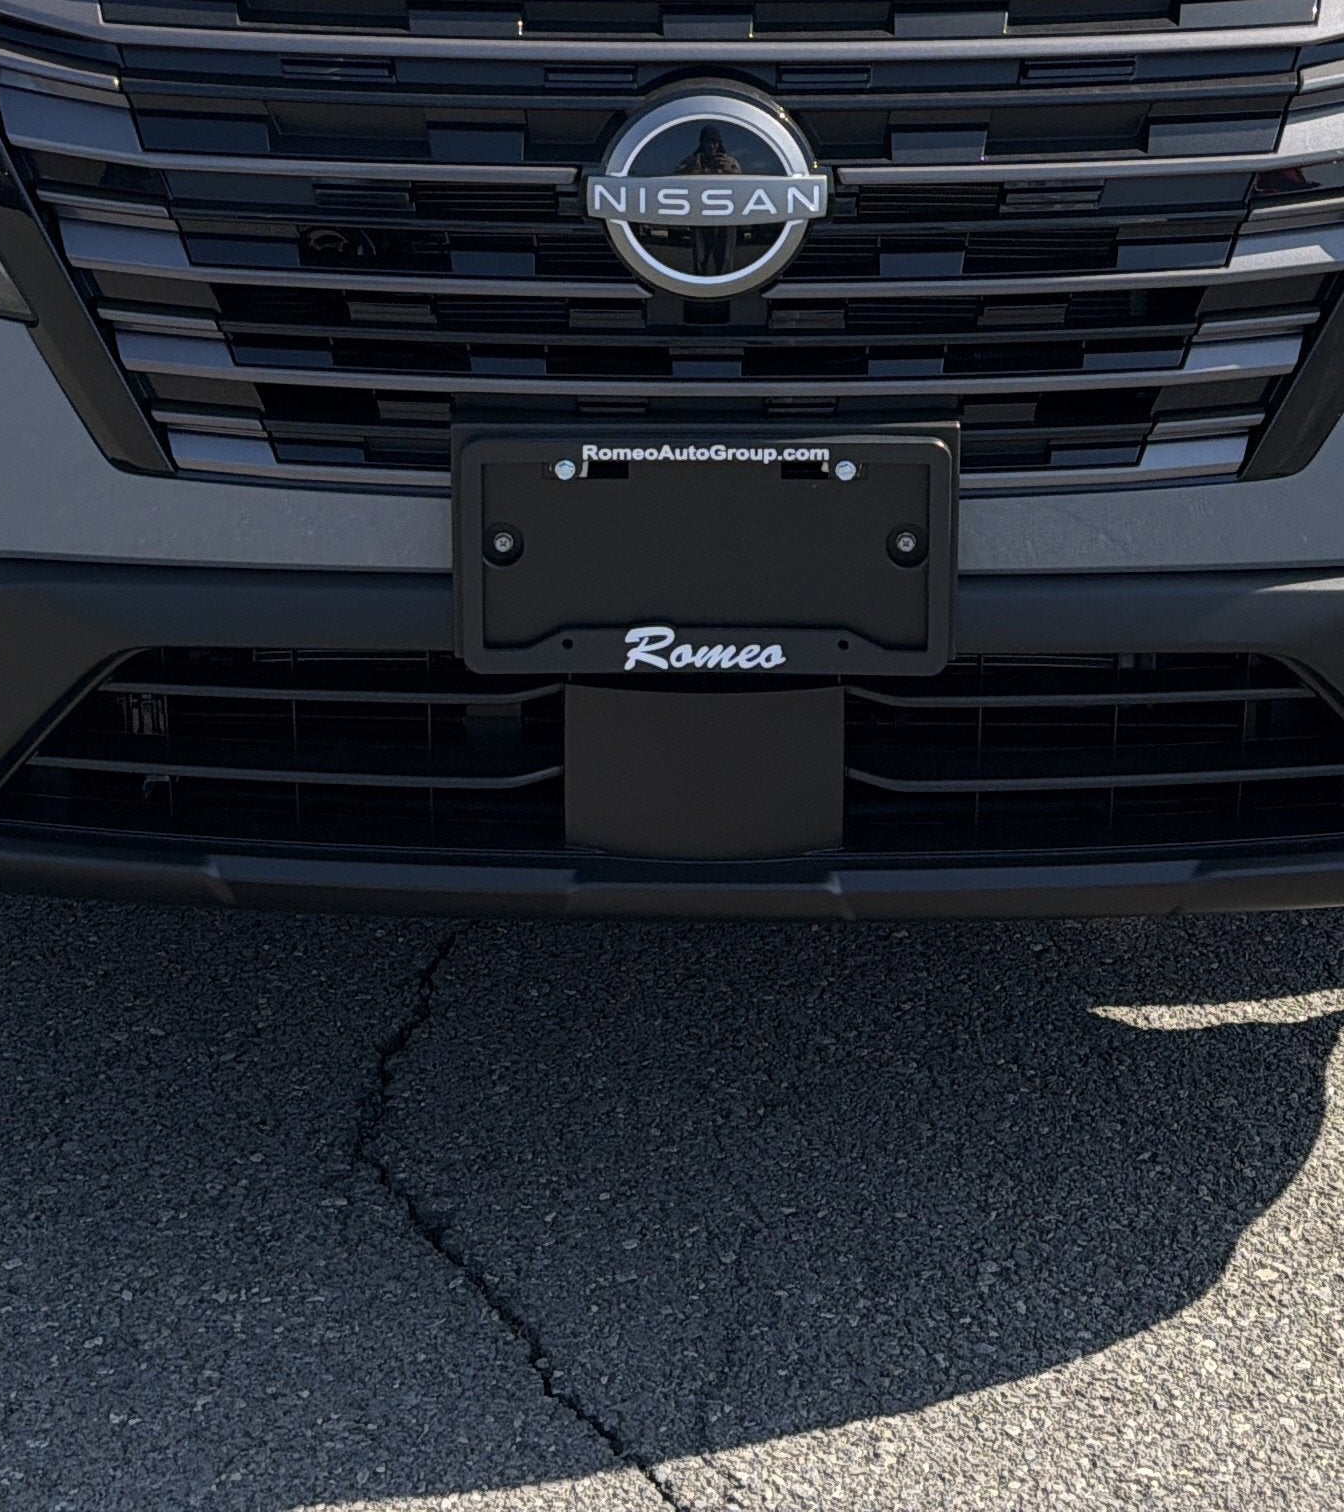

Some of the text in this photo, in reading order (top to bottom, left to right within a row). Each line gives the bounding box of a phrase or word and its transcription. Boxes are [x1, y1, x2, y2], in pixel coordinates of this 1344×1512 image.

[594, 184, 819, 216] NISSAN
[582, 444, 830, 464] RomeoAutoGroup.com
[624, 626, 786, 670] Romeo
